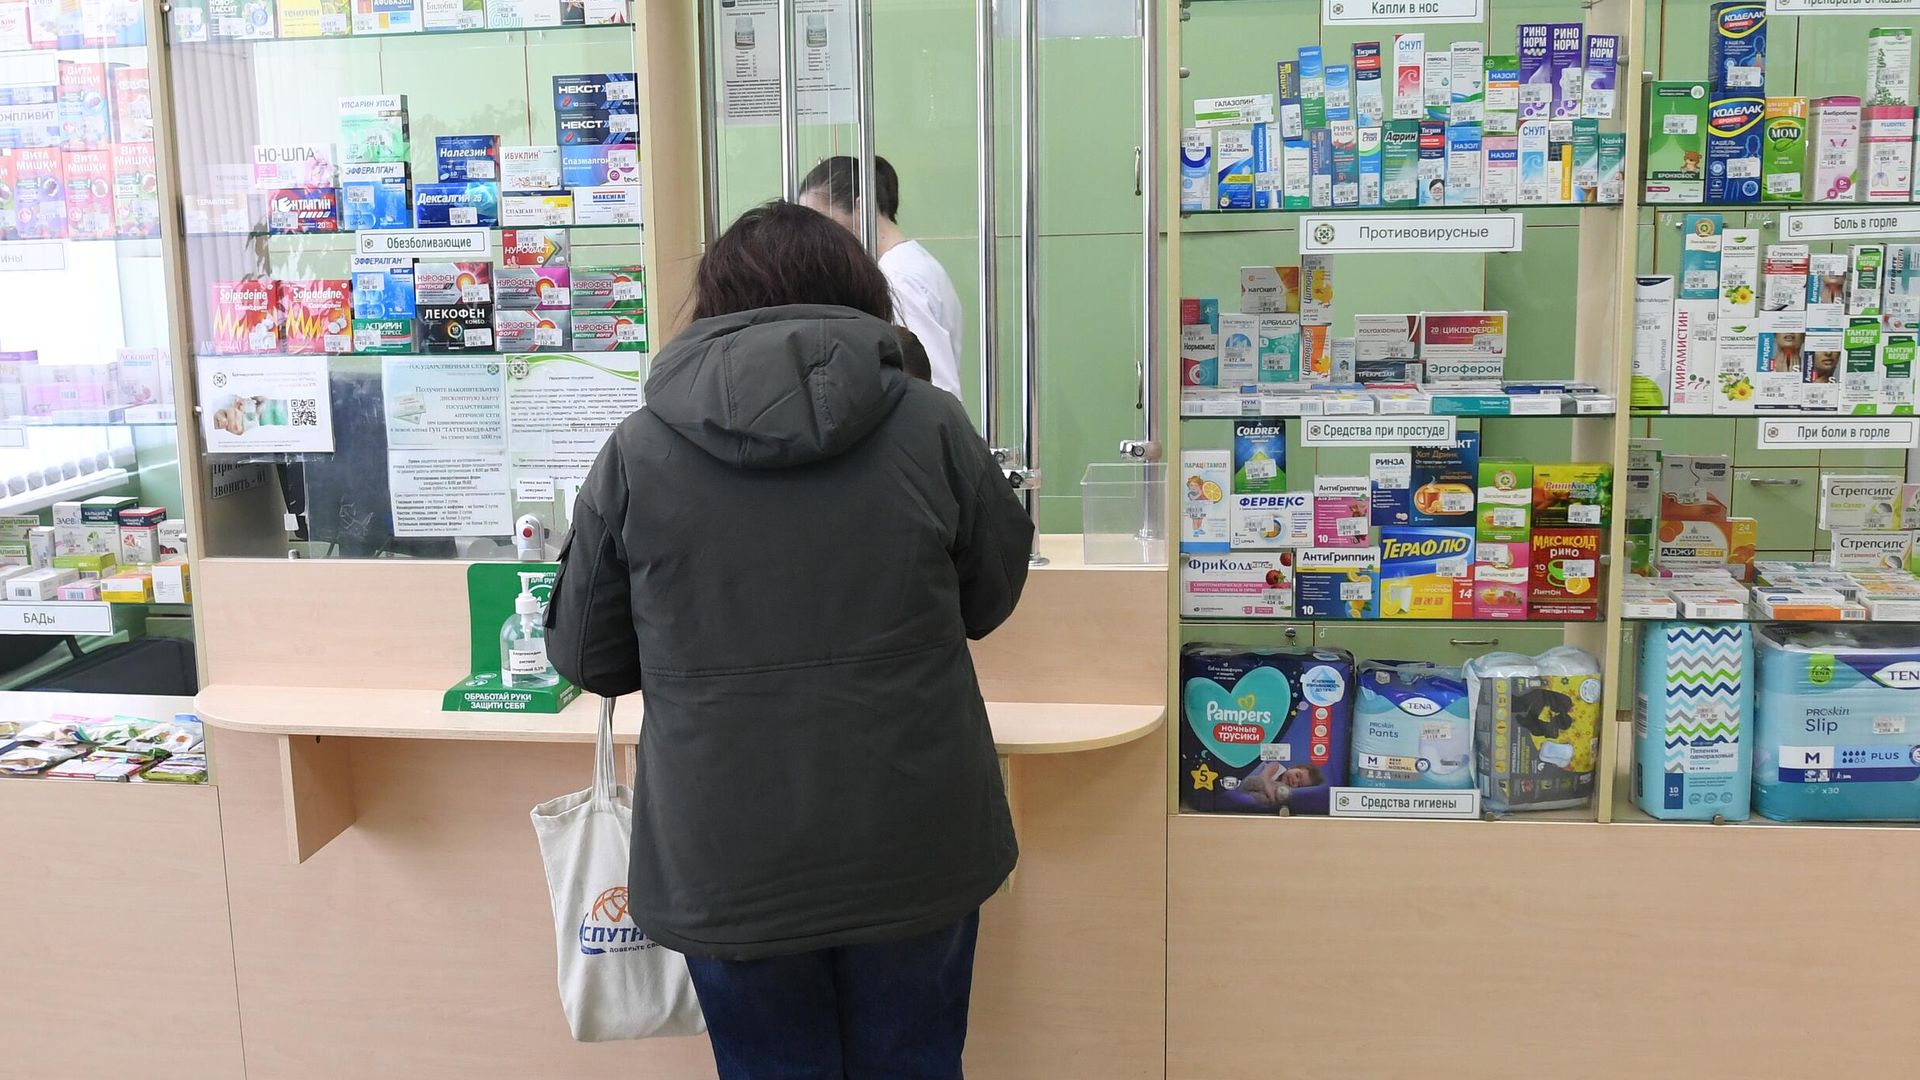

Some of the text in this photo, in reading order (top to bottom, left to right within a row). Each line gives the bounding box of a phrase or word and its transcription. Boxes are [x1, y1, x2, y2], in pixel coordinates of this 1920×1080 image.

[1372, 2, 1439, 14] Капли в нос
[1523, 26, 1547, 36] РИНО
[1554, 28, 1579, 39] РИНО
[1399, 41, 1422, 50] СНУП
[1523, 37, 1546, 47] НОРМ
[1554, 40, 1578, 50] НОРМ
[1590, 38, 1614, 48] РИНО
[1590, 48, 1613, 58] НОРМ
[558, 85, 600, 94] НЕКСТ
[1713, 105, 1762, 118] КОДЕЛАК
[561, 120, 603, 129] НЕКСТ
[1523, 126, 1546, 136] СНУП
[1771, 128, 1798, 138] МОМ
[1386, 132, 1417, 143] Африн
[440, 148, 486, 158] Налгезин
[504, 152, 538, 160] ИБУКЛИН
[346, 166, 394, 175] ЭФФЕРАЛГАН
[418, 193, 470, 205] Дексалгин
[1834, 217, 1897, 231] Боль в горле
[1359, 226, 1489, 243] Противовирусные
[387, 237, 472, 249] Обезболивающие
[220, 289, 267, 300] Solpadeine
[294, 288, 342, 301] Solpadeine
[424, 309, 485, 319] ЛЕКОФЕН
[1184, 343, 1215, 352] Нормомед
[1675, 312, 1688, 390] МИРАМИСТИН
[1429, 364, 1500, 374] Эргоферон
[1237, 426, 1280, 436] COLDREX
[1324, 425, 1445, 438] Средства при простуде
[1797, 426, 1890, 440] При боли в горле
[1319, 485, 1367, 494] АнтиГриппин
[1831, 485, 1895, 497] Стрепсилс
[1239, 497, 1304, 509] ФЕРВЕКС
[1318, 535, 1328, 543] 10
[1533, 535, 1596, 552] МАКСИКОЛД
[1840, 538, 1905, 550] Стрепсилс
[1382, 538, 1466, 560] ТЕРАФЛЮ
[1550, 548, 1580, 558] рино
[1302, 552, 1375, 564] АнтиГриппин
[1188, 560, 1252, 573] ФриКолд
[1459, 589, 1472, 598] 14
[1302, 606, 1314, 615] 10
[23, 613, 55, 624] БАДы
[464, 692, 509, 700] ОБРАБОТАЙ
[1206, 700, 1271, 725] Pampers
[1805, 718, 1838, 735] Slip
[1218, 732, 1259, 741] трусики
[1369, 728, 1398, 738] Pants
[1368, 756, 1378, 765] M
[1805, 752, 1820, 764] M
[1871, 752, 1899, 760] PLUS
[1200, 770, 1208, 782] 5
[1361, 796, 1456, 810] Средства гигиены
